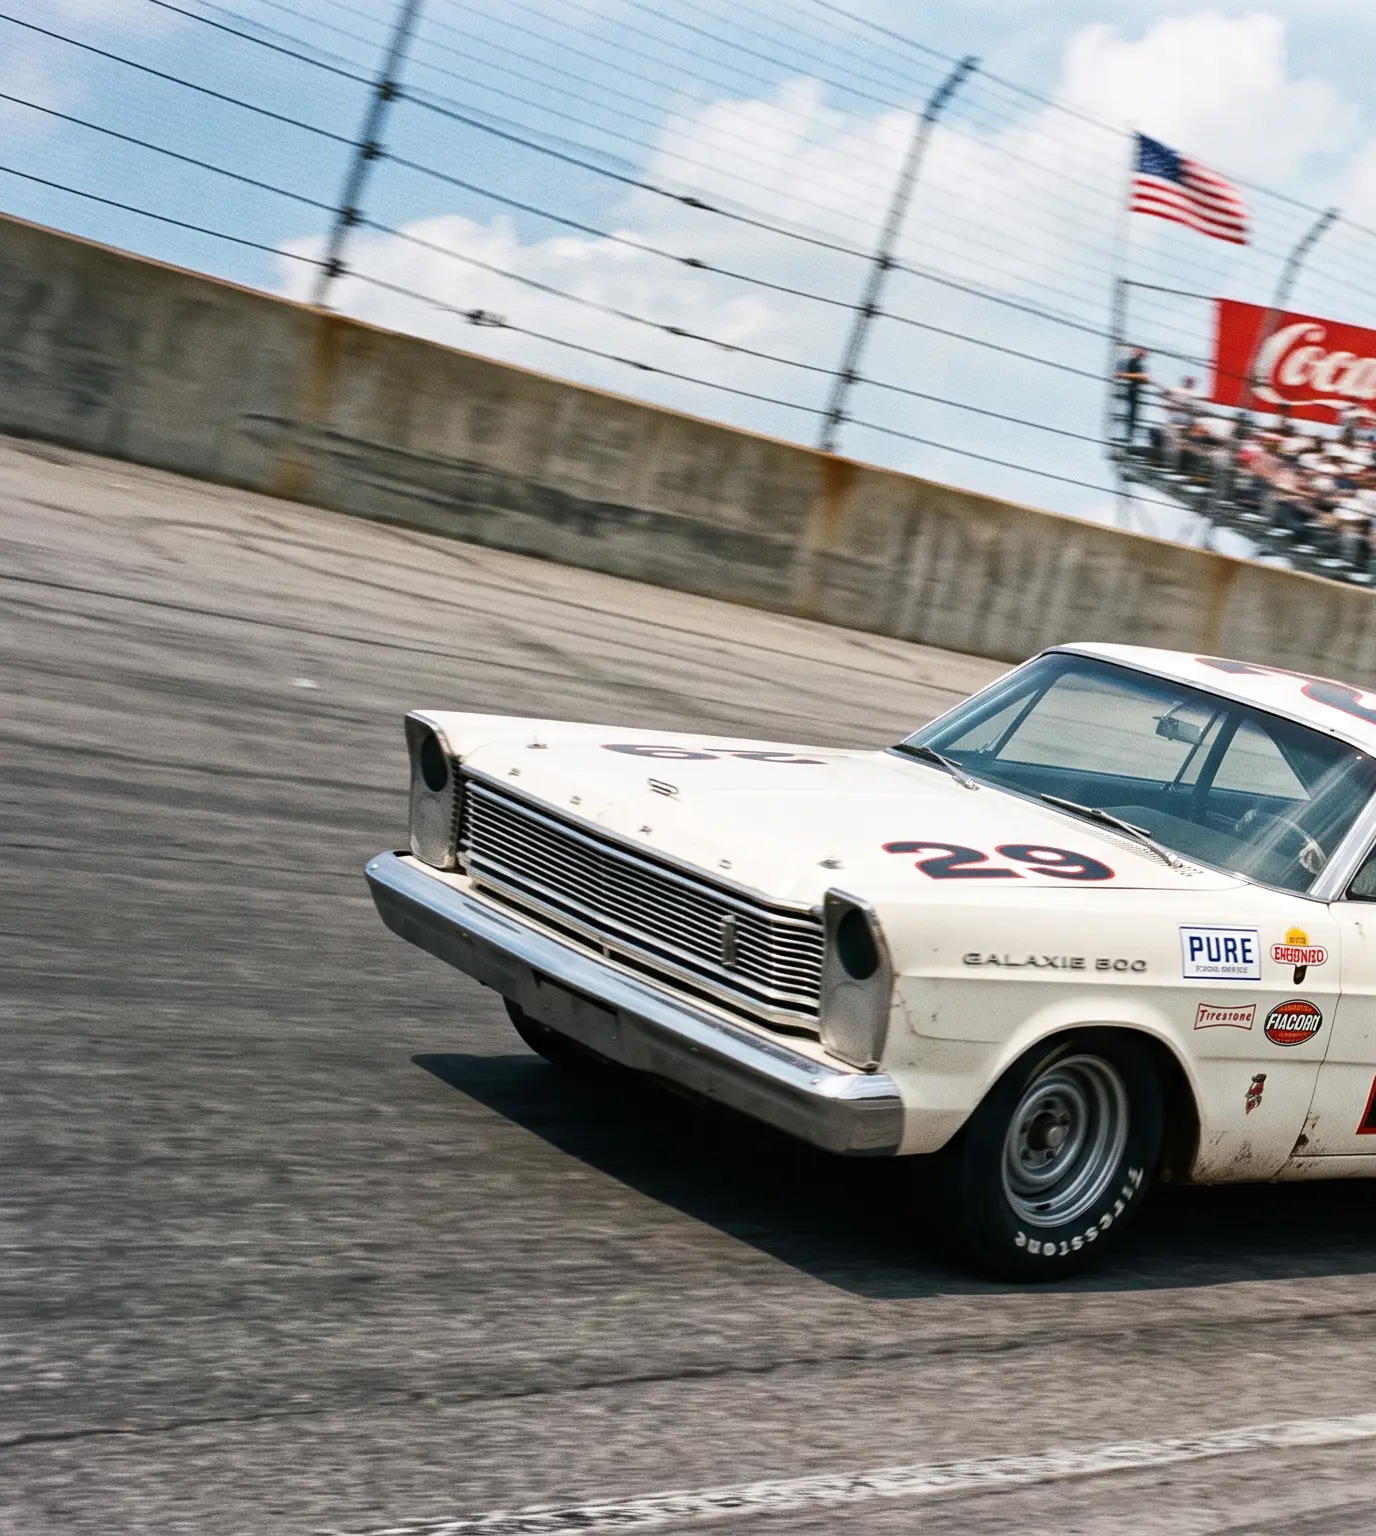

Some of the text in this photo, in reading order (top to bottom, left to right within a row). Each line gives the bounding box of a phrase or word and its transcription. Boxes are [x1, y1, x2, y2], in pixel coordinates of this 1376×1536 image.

[882, 841, 1116, 880] 29
[962, 952, 1087, 971] GALAXIE
[1189, 936, 1254, 964] PURE
